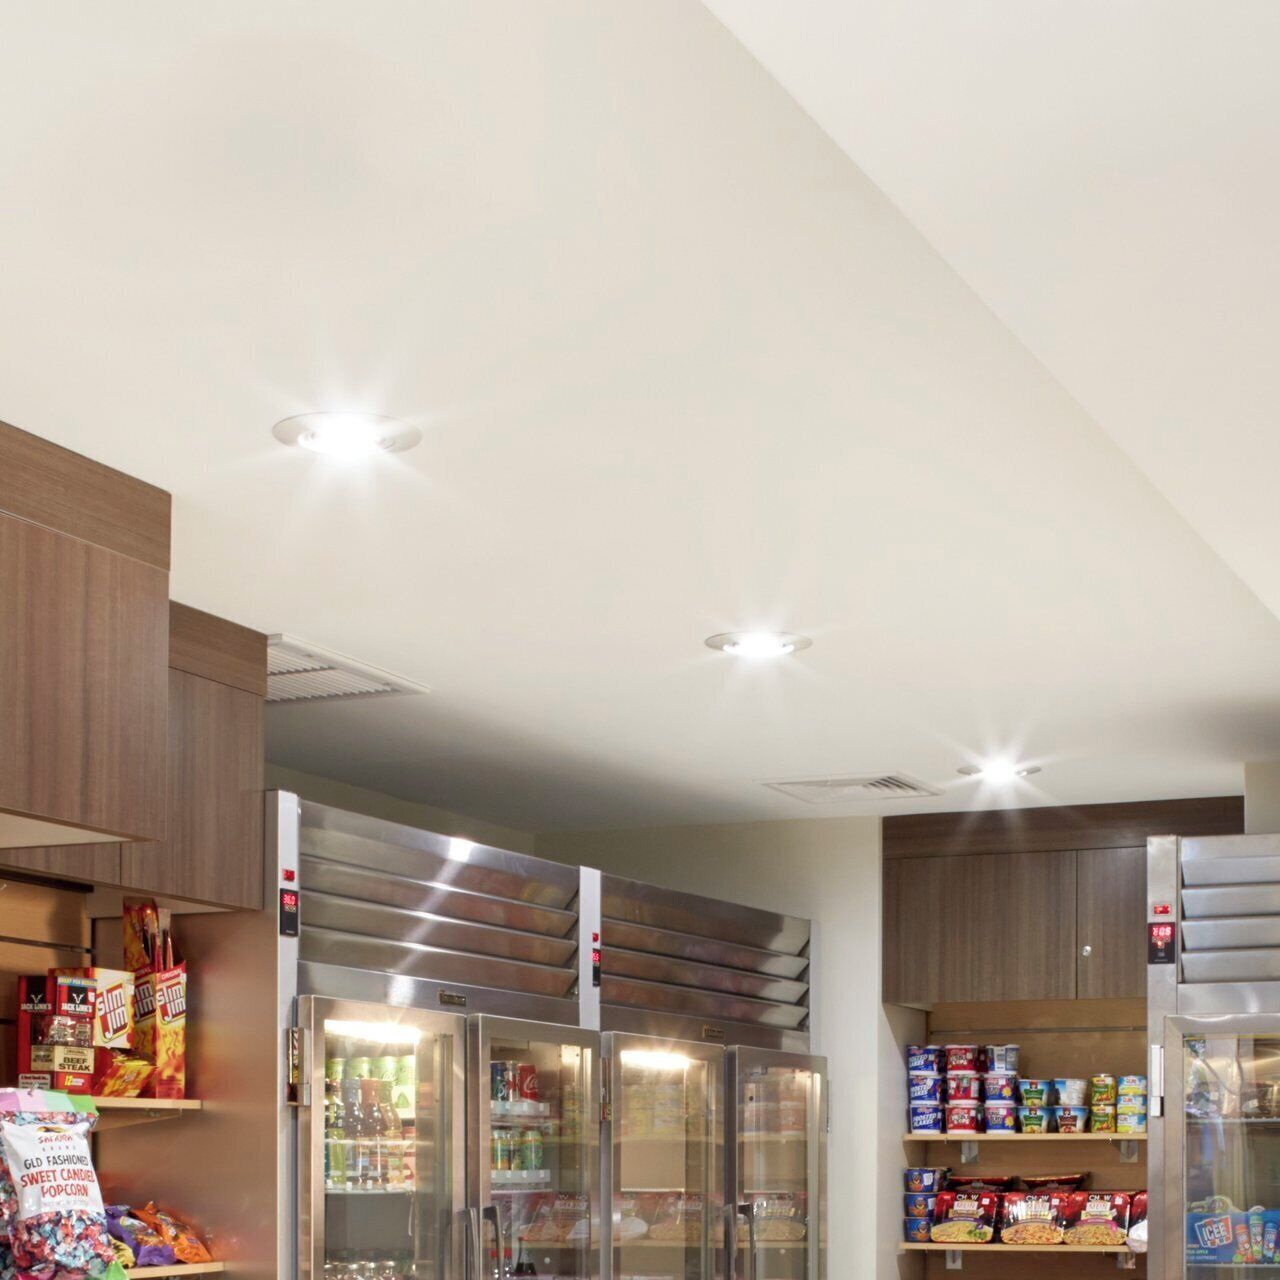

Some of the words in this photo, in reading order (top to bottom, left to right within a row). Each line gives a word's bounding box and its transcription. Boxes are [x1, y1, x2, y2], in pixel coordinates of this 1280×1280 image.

[61, 1003, 75, 1012] JACK
[59, 1064, 91, 1072] STEAK
[46, 1155, 89, 1166] FASHIONED
[20, 1174, 57, 1187] SWEET
[59, 1170, 95, 1183] CANDIED
[41, 1185, 89, 1198] POPCORN
